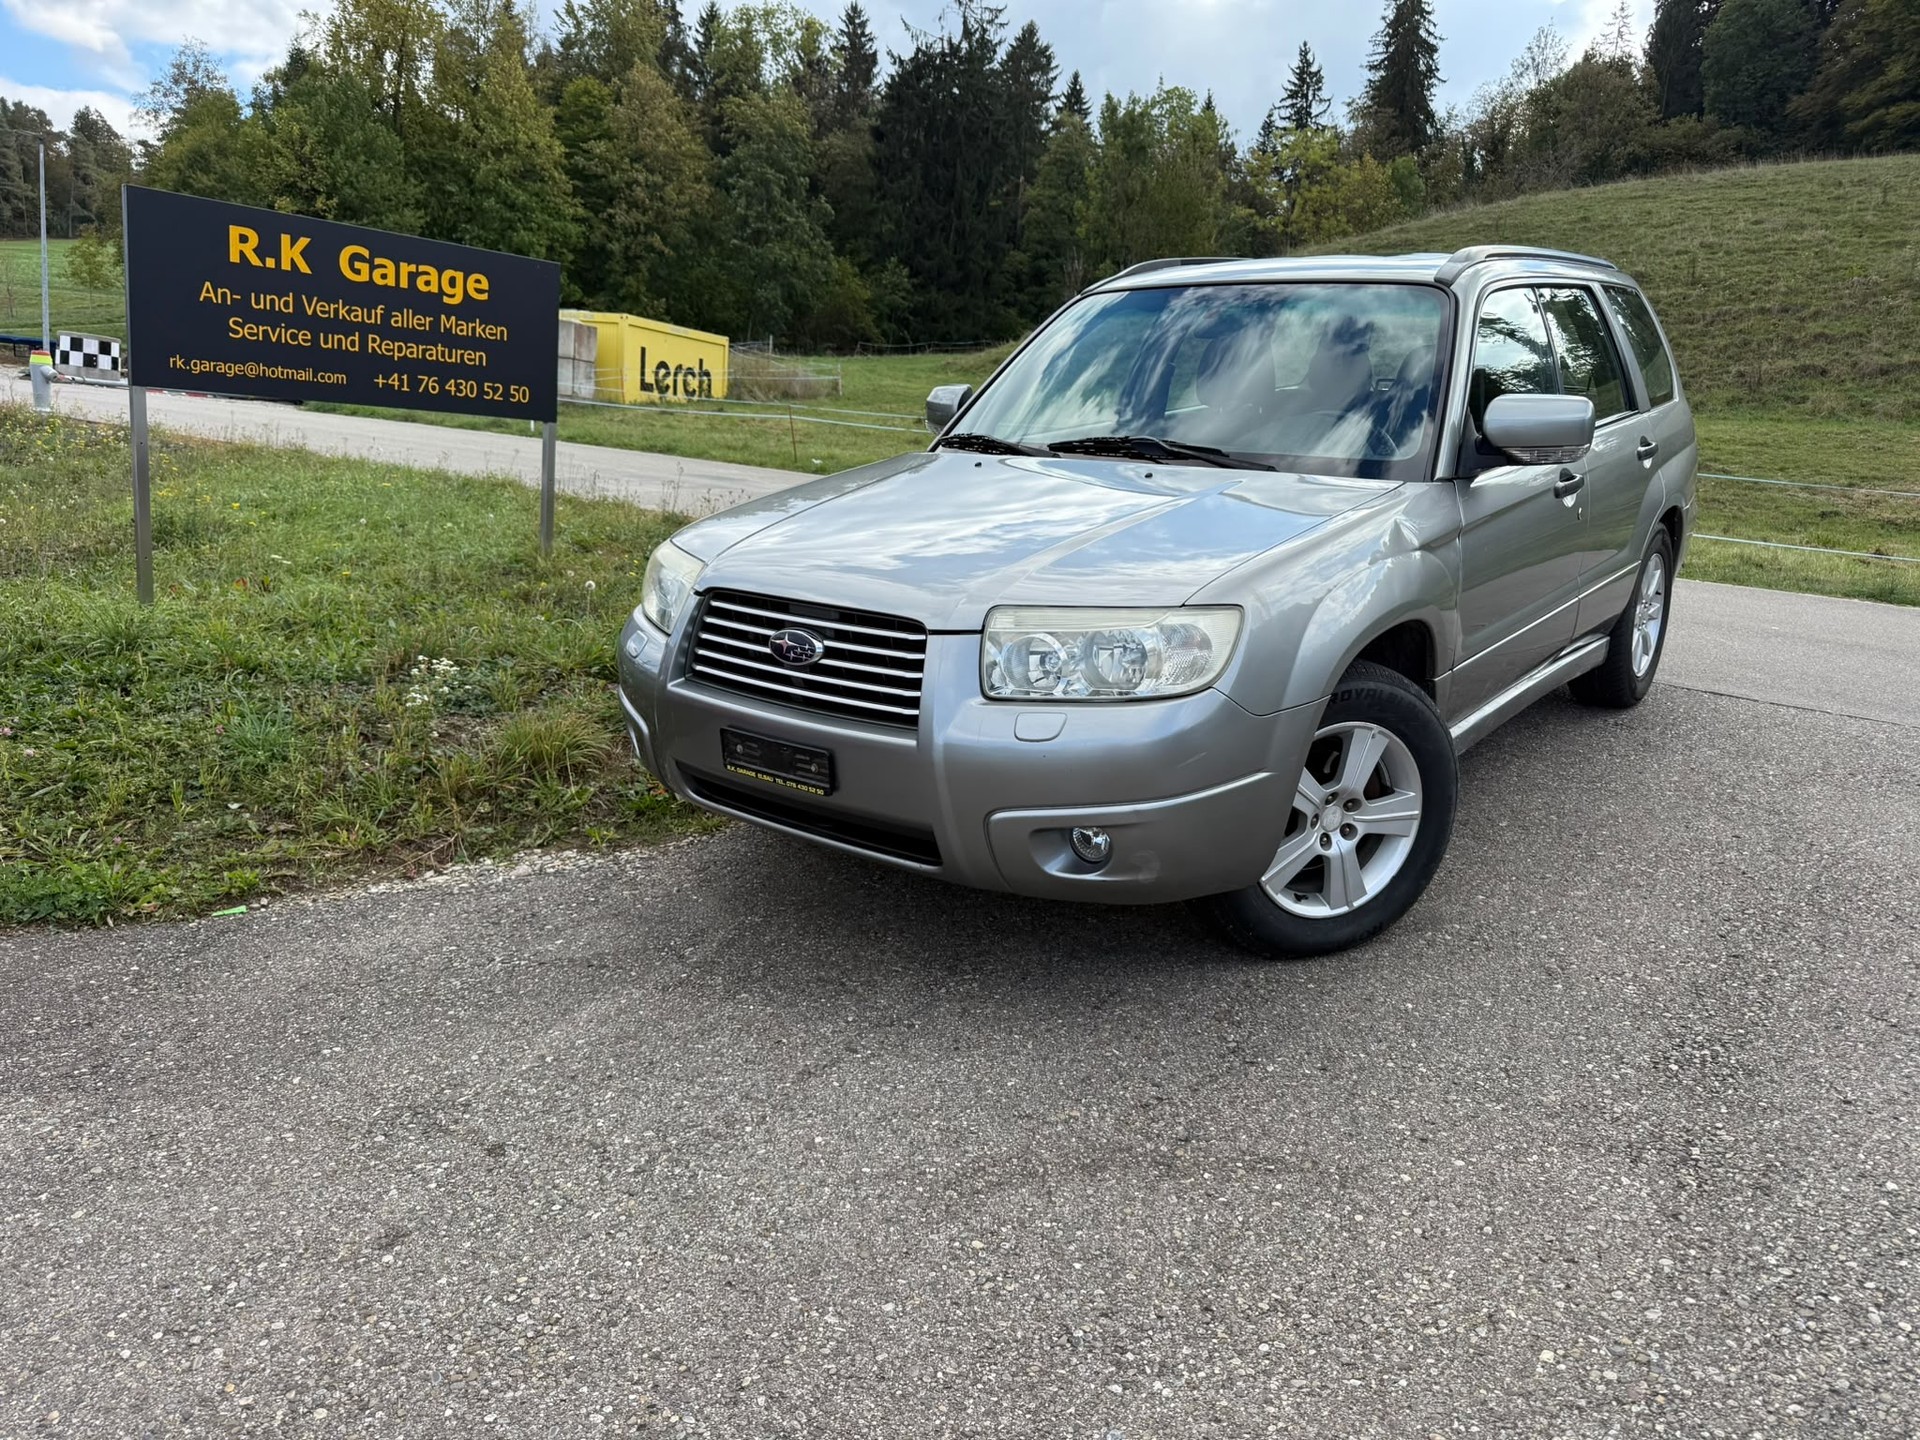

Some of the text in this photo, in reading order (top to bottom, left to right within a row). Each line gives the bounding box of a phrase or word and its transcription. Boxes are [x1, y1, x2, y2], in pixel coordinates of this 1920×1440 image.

[228, 224, 491, 305] R.K Garage
[199, 281, 509, 342] An- und Verkauf aller Marken
[228, 317, 488, 367] Service und Reparaturen
[168, 355, 348, 385] rk.garage@hotmail.com
[373, 374, 531, 404] +41 76 430 52 50
[640, 346, 713, 398] Lerch
[737, 767, 756, 777] GARAGE
